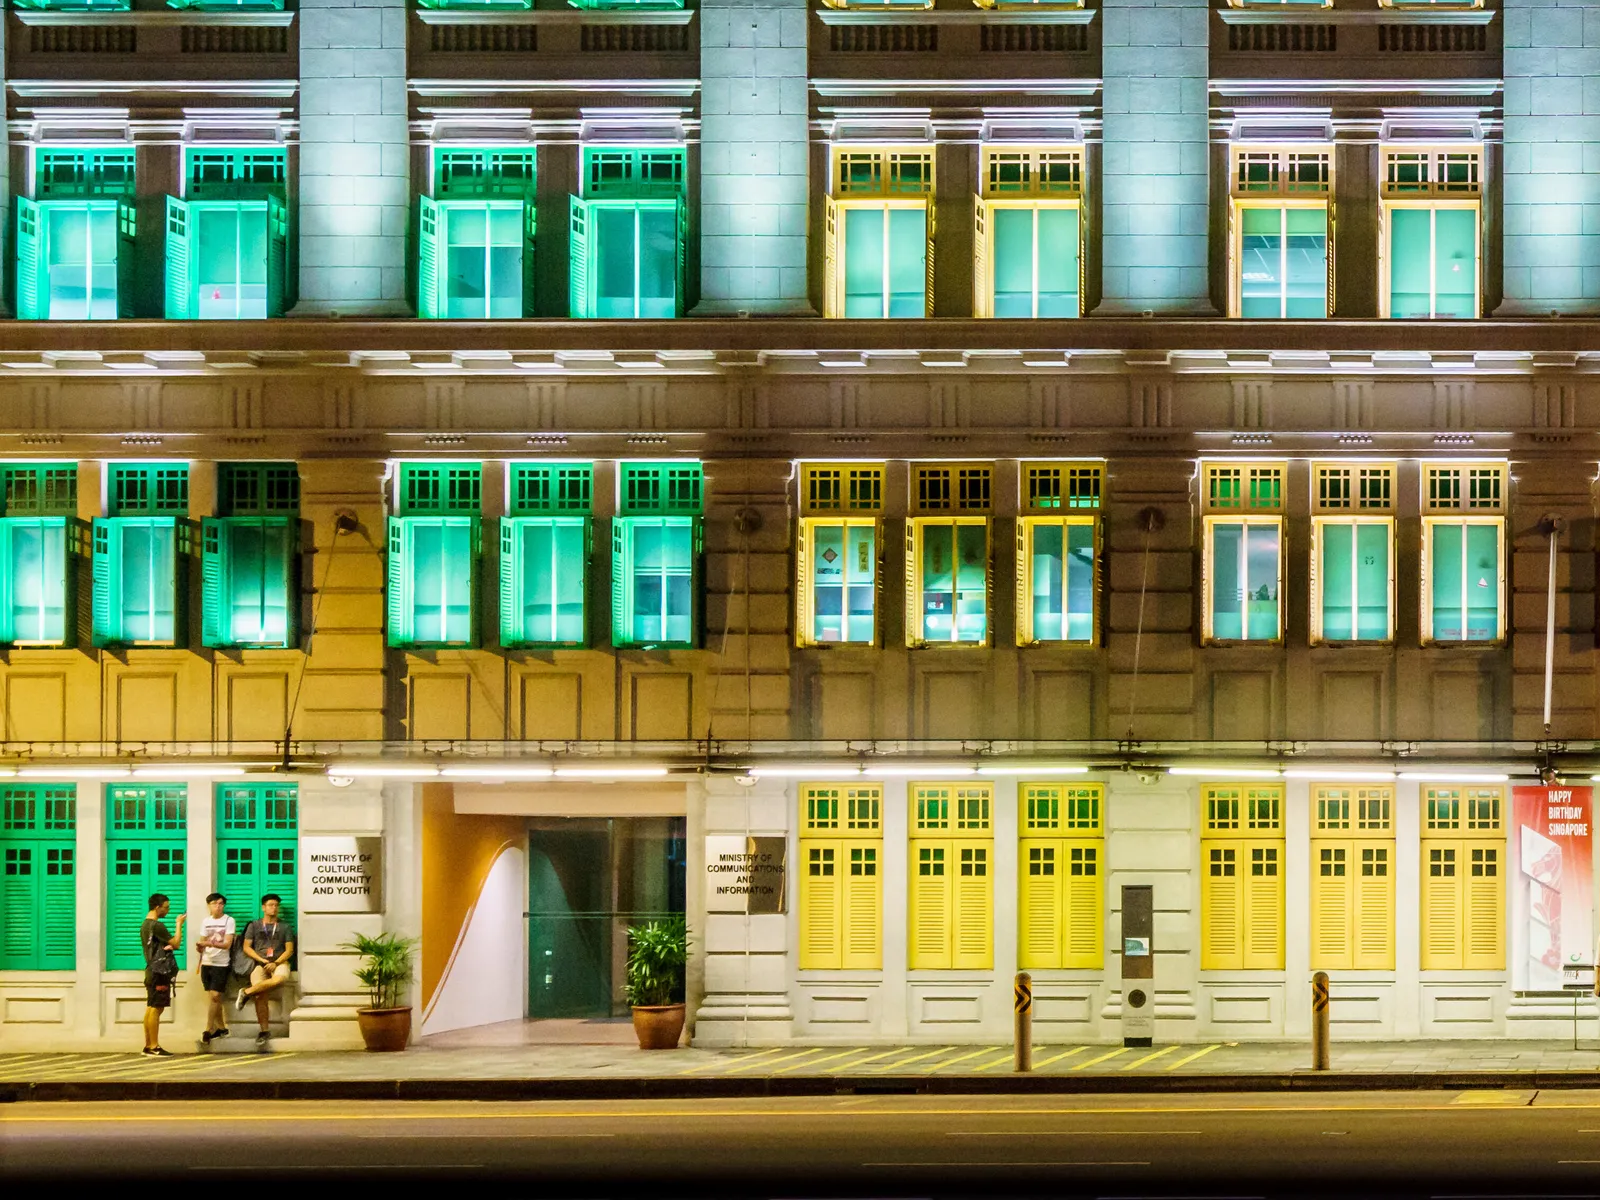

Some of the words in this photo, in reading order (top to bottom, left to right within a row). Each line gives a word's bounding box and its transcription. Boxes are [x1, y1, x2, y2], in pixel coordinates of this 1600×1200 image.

[1548, 790, 1572, 803] HAPPY
[1548, 806, 1583, 819] BIRTHDAY
[1548, 823, 1588, 836] SINGAPORE
[310, 854, 356, 862] MINISTRY
[359, 854, 373, 862] OF
[719, 854, 758, 862] MINISTRY
[761, 854, 772, 862] OF
[317, 865, 366, 874] CULTURE,
[707, 864, 785, 873] COMMUNICATIONS
[311, 876, 371, 884] COMMUNITY
[736, 875, 755, 884] AND
[312, 886, 334, 895] AND
[337, 886, 371, 895] YOUTH
[716, 886, 774, 895] INFORMATION
